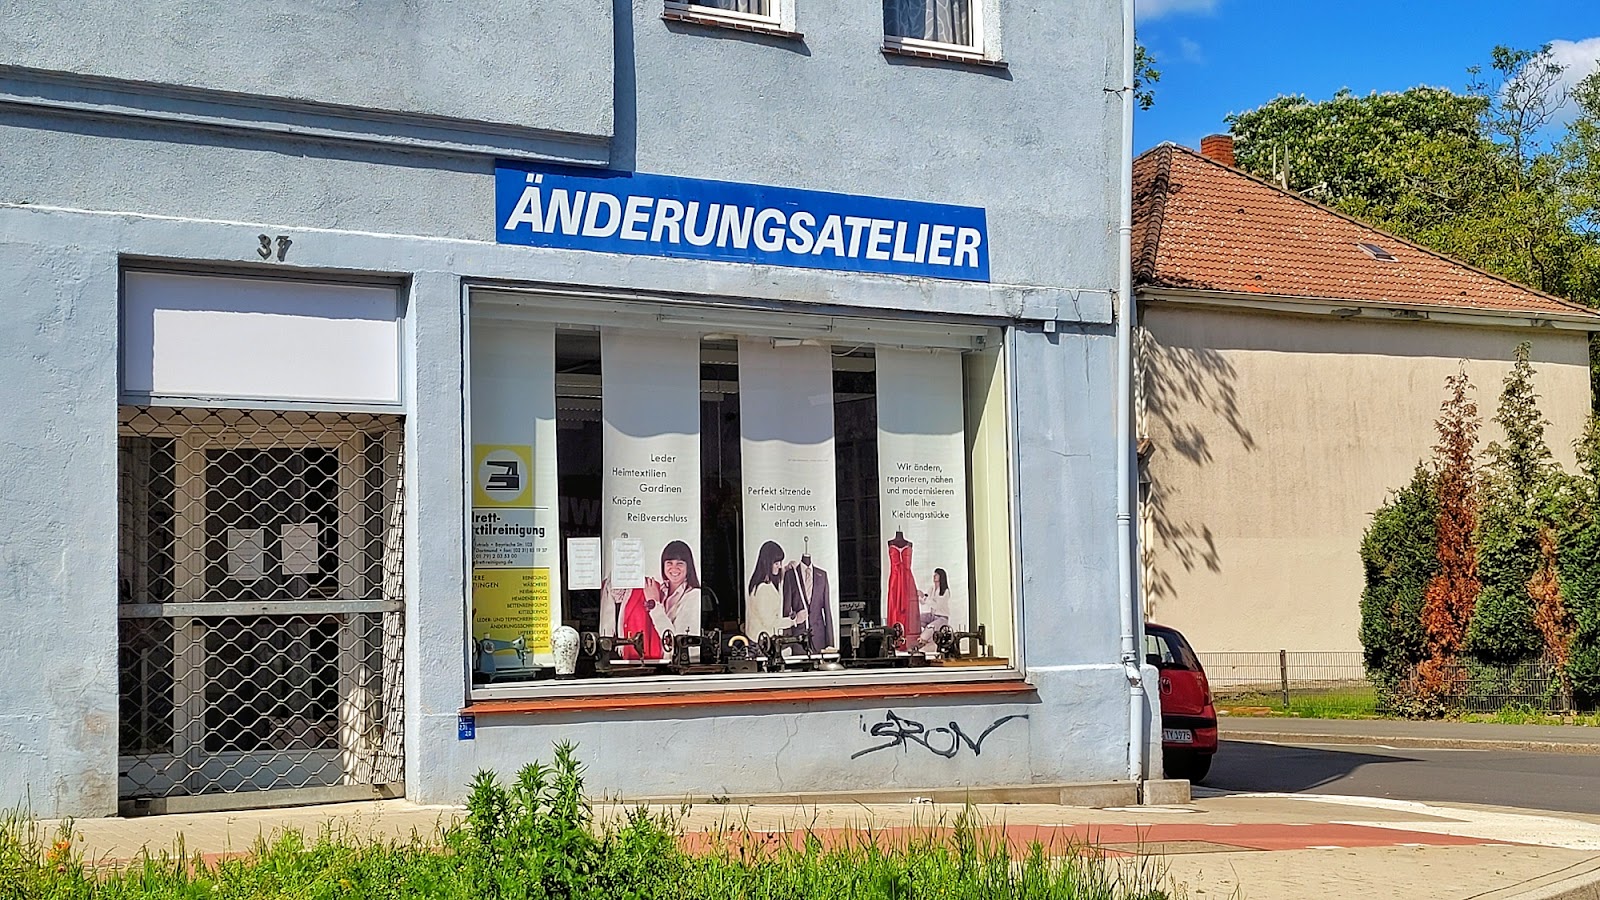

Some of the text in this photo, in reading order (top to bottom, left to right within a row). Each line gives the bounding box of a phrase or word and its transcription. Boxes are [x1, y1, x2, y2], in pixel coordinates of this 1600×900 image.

[504, 173, 982, 268] ÄNDERUNGSATELIER
[256, 233, 293, 262] 37
[650, 453, 677, 463] Leder
[612, 466, 667, 478] Heimtextilien
[896, 462, 943, 473] Wir ändern,
[886, 474, 954, 485] reparieren, nähen
[639, 483, 682, 493] Gardinen
[747, 486, 812, 496] Perfekt sitzende
[886, 486, 955, 496] und modernisieren
[612, 495, 642, 507] Knöpfe
[905, 498, 937, 507] alle Ihre
[760, 502, 817, 513] Kleidung muss
[627, 512, 688, 523] Reißverschluss
[891, 509, 950, 521] Kleidungsstücke
[774, 518, 828, 528] einfach sein...
